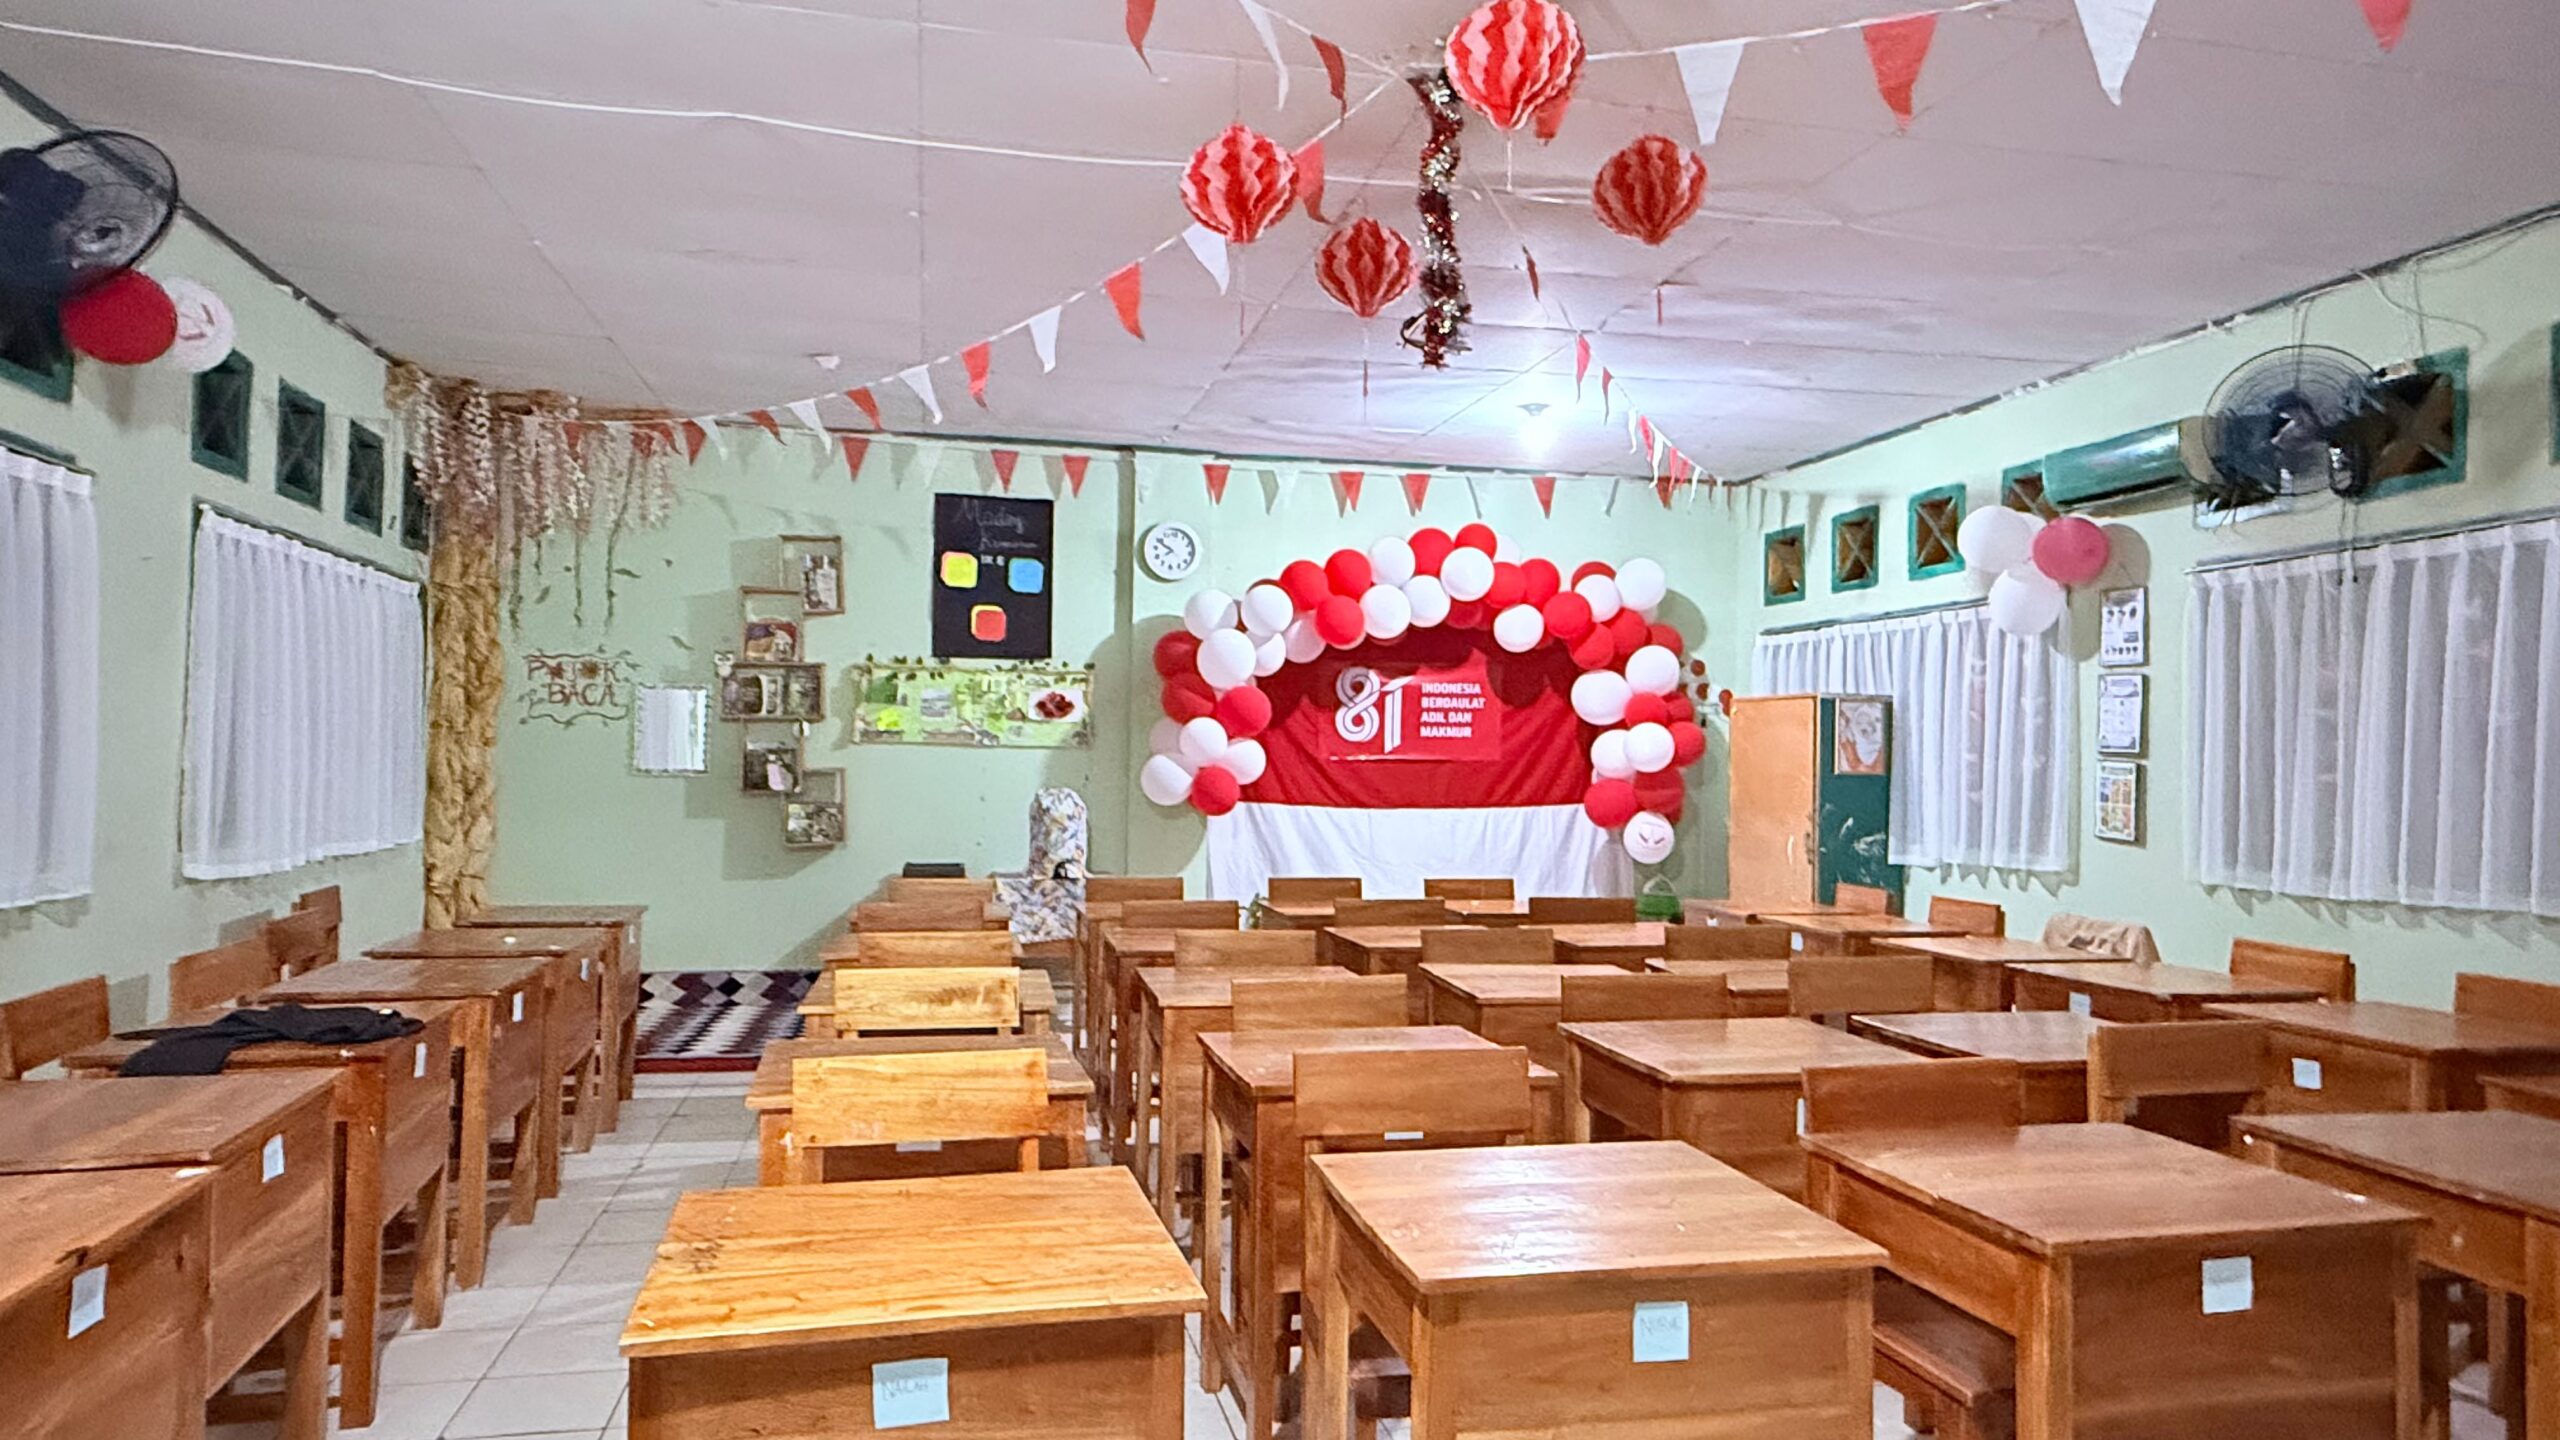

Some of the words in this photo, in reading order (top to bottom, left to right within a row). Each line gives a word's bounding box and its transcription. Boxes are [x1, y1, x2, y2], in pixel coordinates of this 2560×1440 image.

[1421, 682, 1481, 694] INDONESIA
[1421, 697, 1486, 709] BERDAULAT
[1335, 667, 1415, 754] 81
[1420, 711, 1446, 723] ADIL
[1448, 711, 1472, 723] DAN
[1420, 726, 1472, 738] MAKMUR
